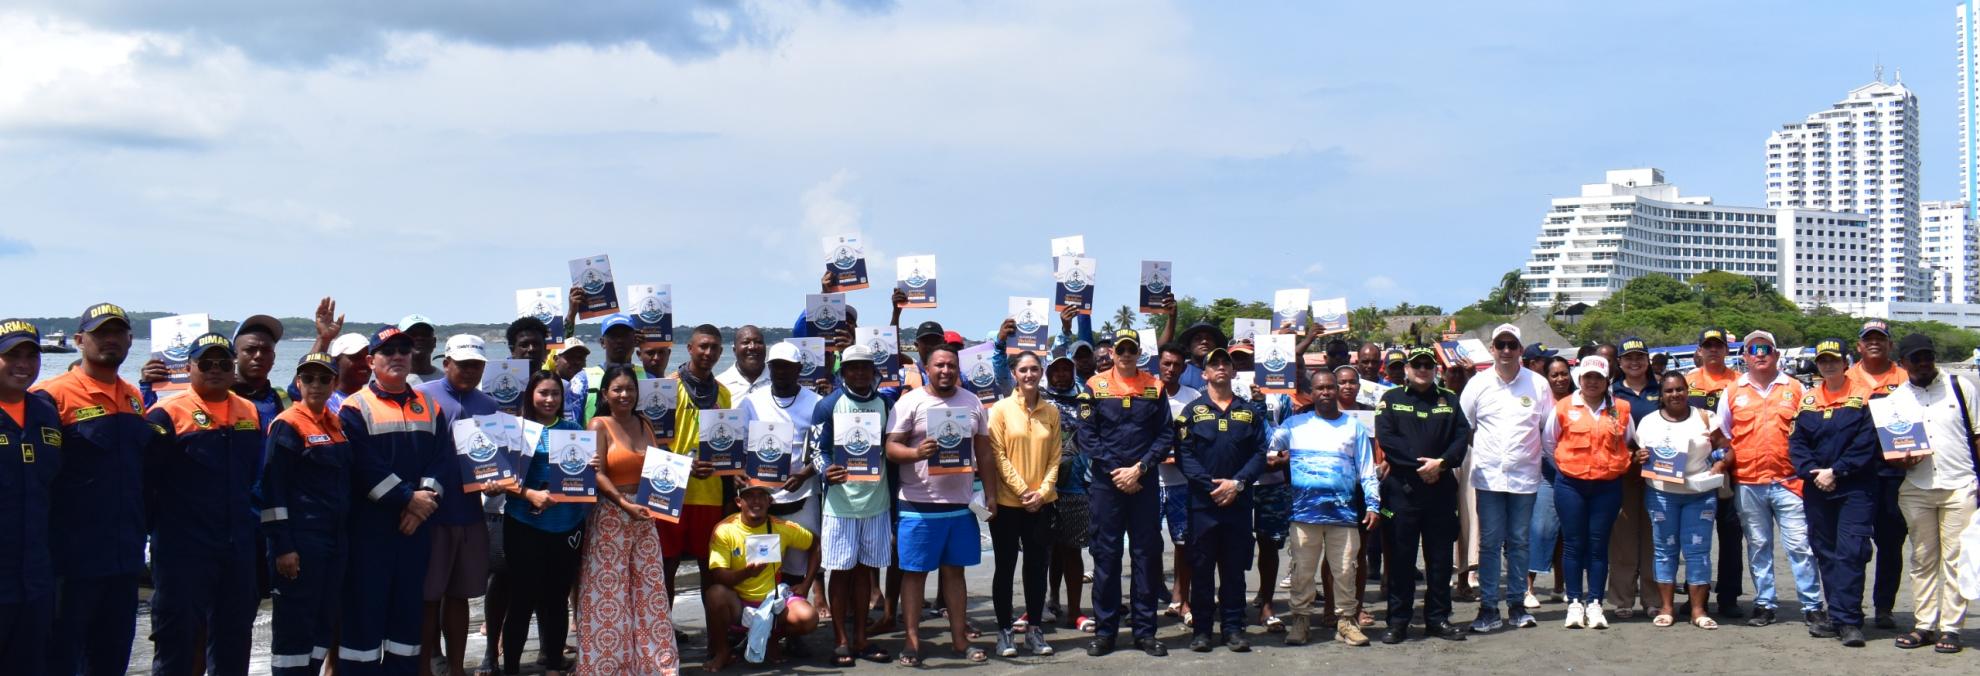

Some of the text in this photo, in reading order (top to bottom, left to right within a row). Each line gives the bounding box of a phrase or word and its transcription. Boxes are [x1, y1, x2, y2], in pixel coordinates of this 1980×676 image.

[199, 335, 230, 348] DIMAR
[1623, 340, 1644, 351] DIMAR
[1817, 341, 1840, 352] DIMAR
